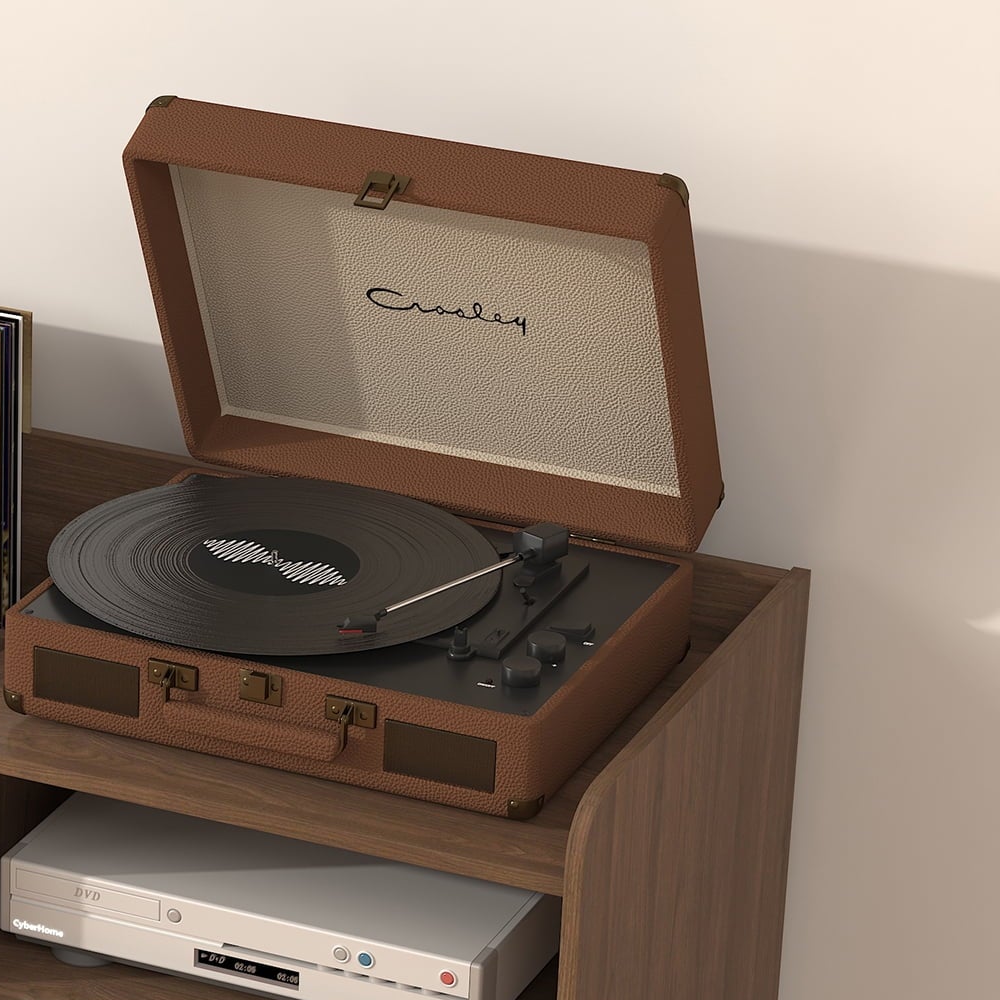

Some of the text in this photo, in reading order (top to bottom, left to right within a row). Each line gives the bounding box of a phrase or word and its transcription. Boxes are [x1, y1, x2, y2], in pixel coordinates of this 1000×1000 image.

[366, 287, 527, 337] Crosley
[73, 887, 101, 901] DVD
[12, 918, 64, 938] CyberHome
